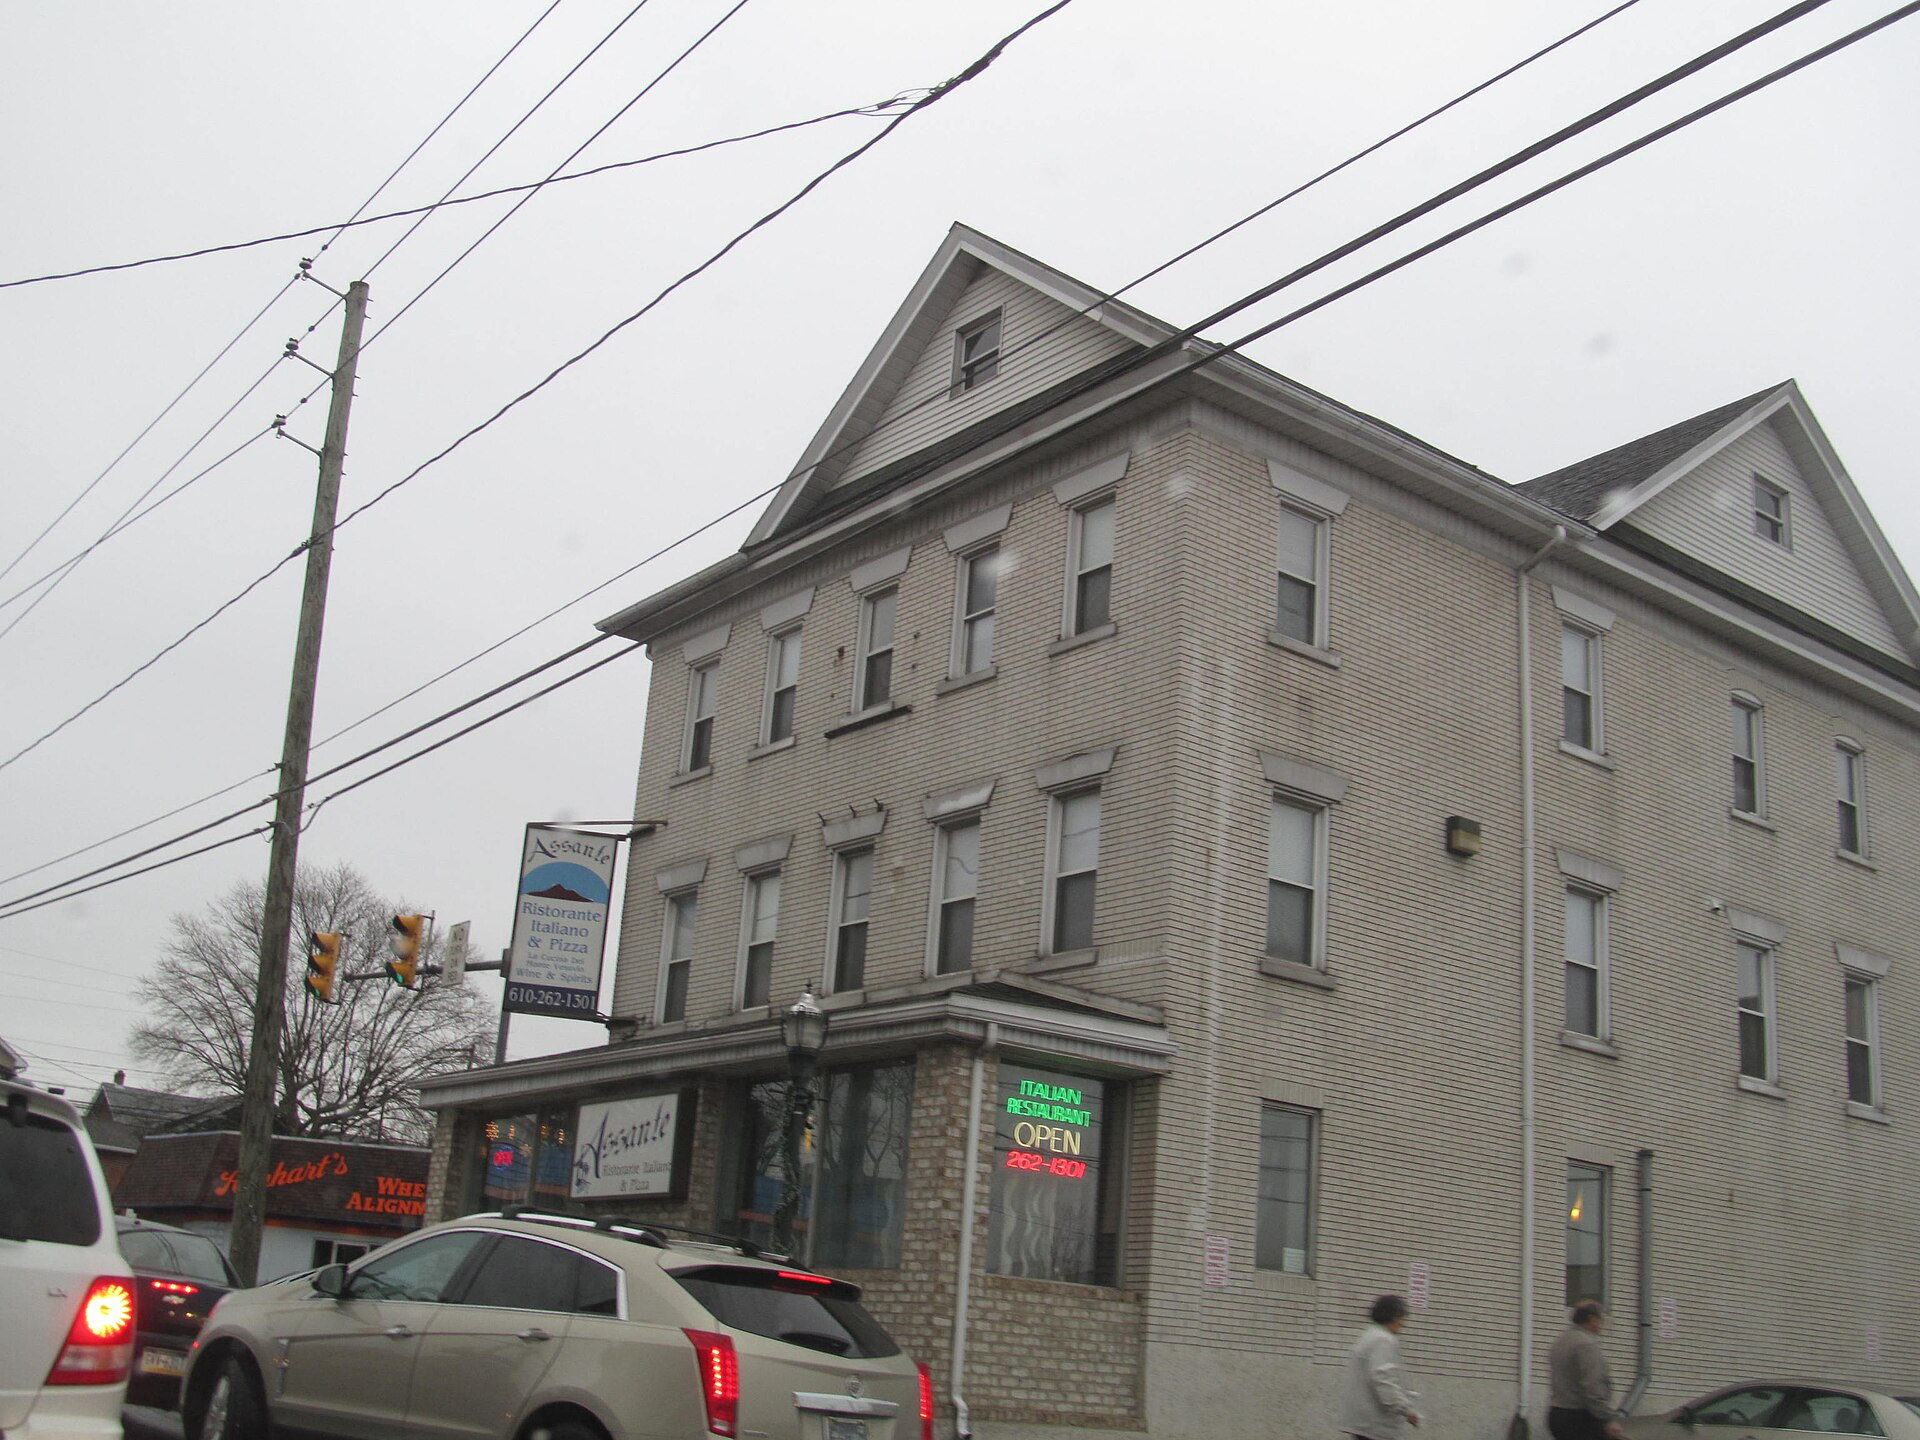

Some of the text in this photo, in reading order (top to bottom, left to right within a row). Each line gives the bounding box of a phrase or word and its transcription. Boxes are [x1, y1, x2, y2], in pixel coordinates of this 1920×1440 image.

[528, 835, 611, 865] Assante
[522, 902, 602, 922] Ristorante
[531, 919, 589, 938] Italiano
[527, 936, 588, 954] & Pizza
[516, 967, 593, 984] Wine & Spirits
[1020, 1080, 1081, 1104] ITALIAN
[1006, 1097, 1092, 1127] RESTAURANT
[1013, 1121, 1081, 1156] OPEN
[1006, 1150, 1086, 1177] 262-1301
[377, 1176, 425, 1198] WHE
[345, 1191, 426, 1216] ALIGNM
